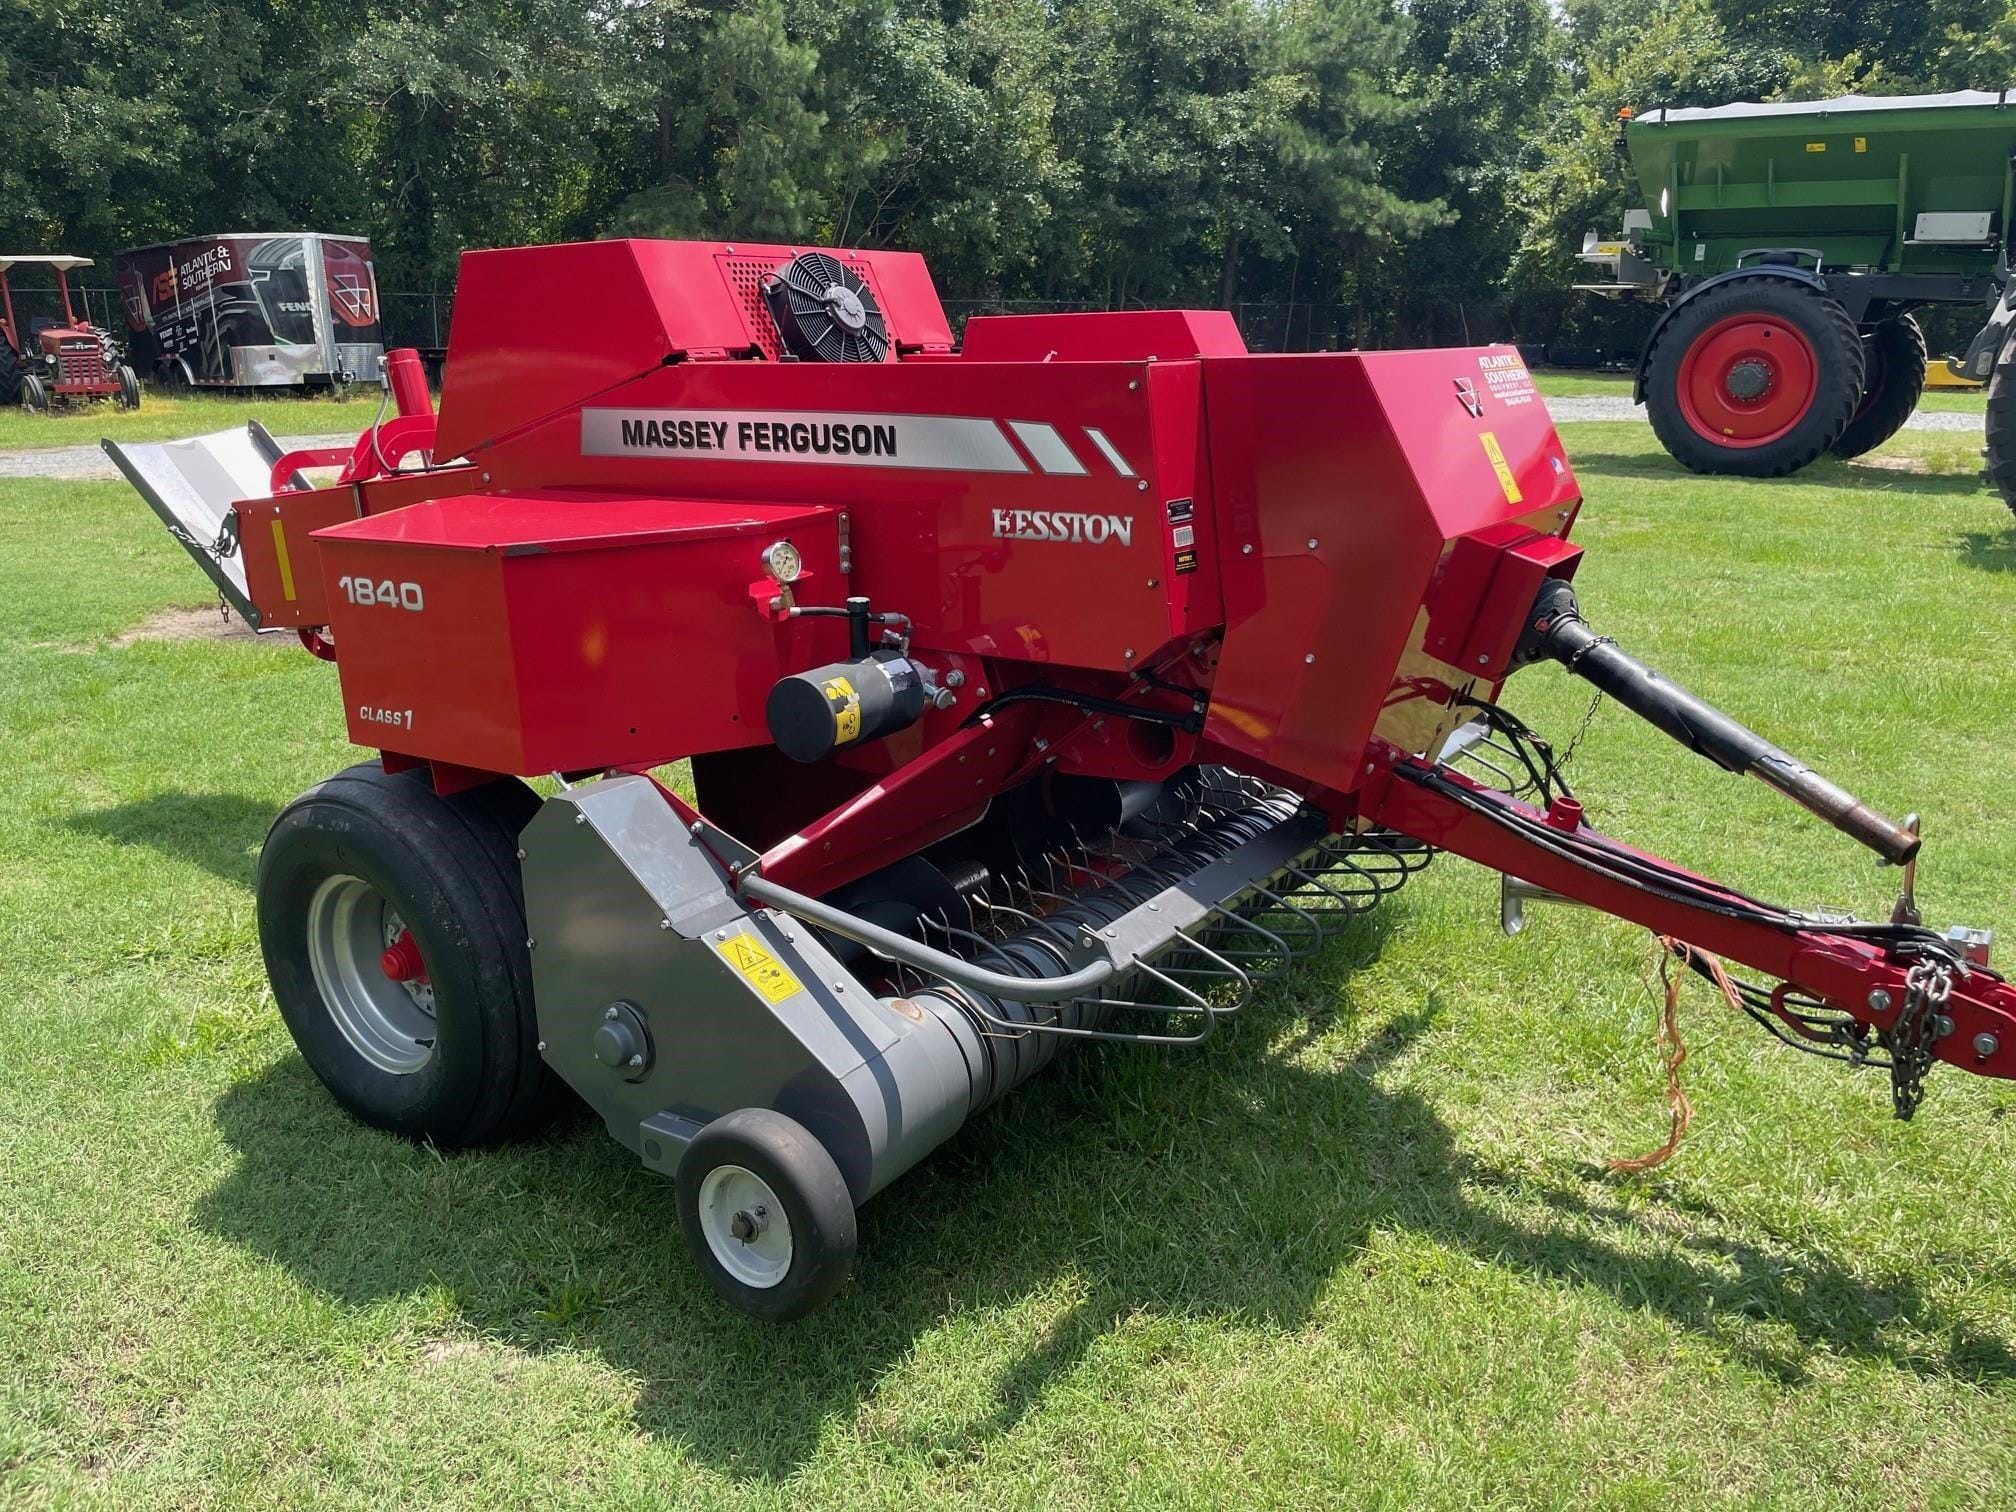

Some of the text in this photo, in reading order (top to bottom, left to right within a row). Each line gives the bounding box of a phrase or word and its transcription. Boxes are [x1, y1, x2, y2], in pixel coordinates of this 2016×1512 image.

[180, 245, 230, 278] ATLANTIC &
[182, 258, 232, 290] SOUTHERN
[1478, 355, 1512, 369] ATLANTIC
[1483, 368, 1529, 385] SOUTHERN
[621, 419, 898, 457] MASSEY FERGUSON
[992, 508, 1133, 547] HESSTON
[338, 576, 424, 611] 1840
[360, 706, 413, 731] CLASS 1
